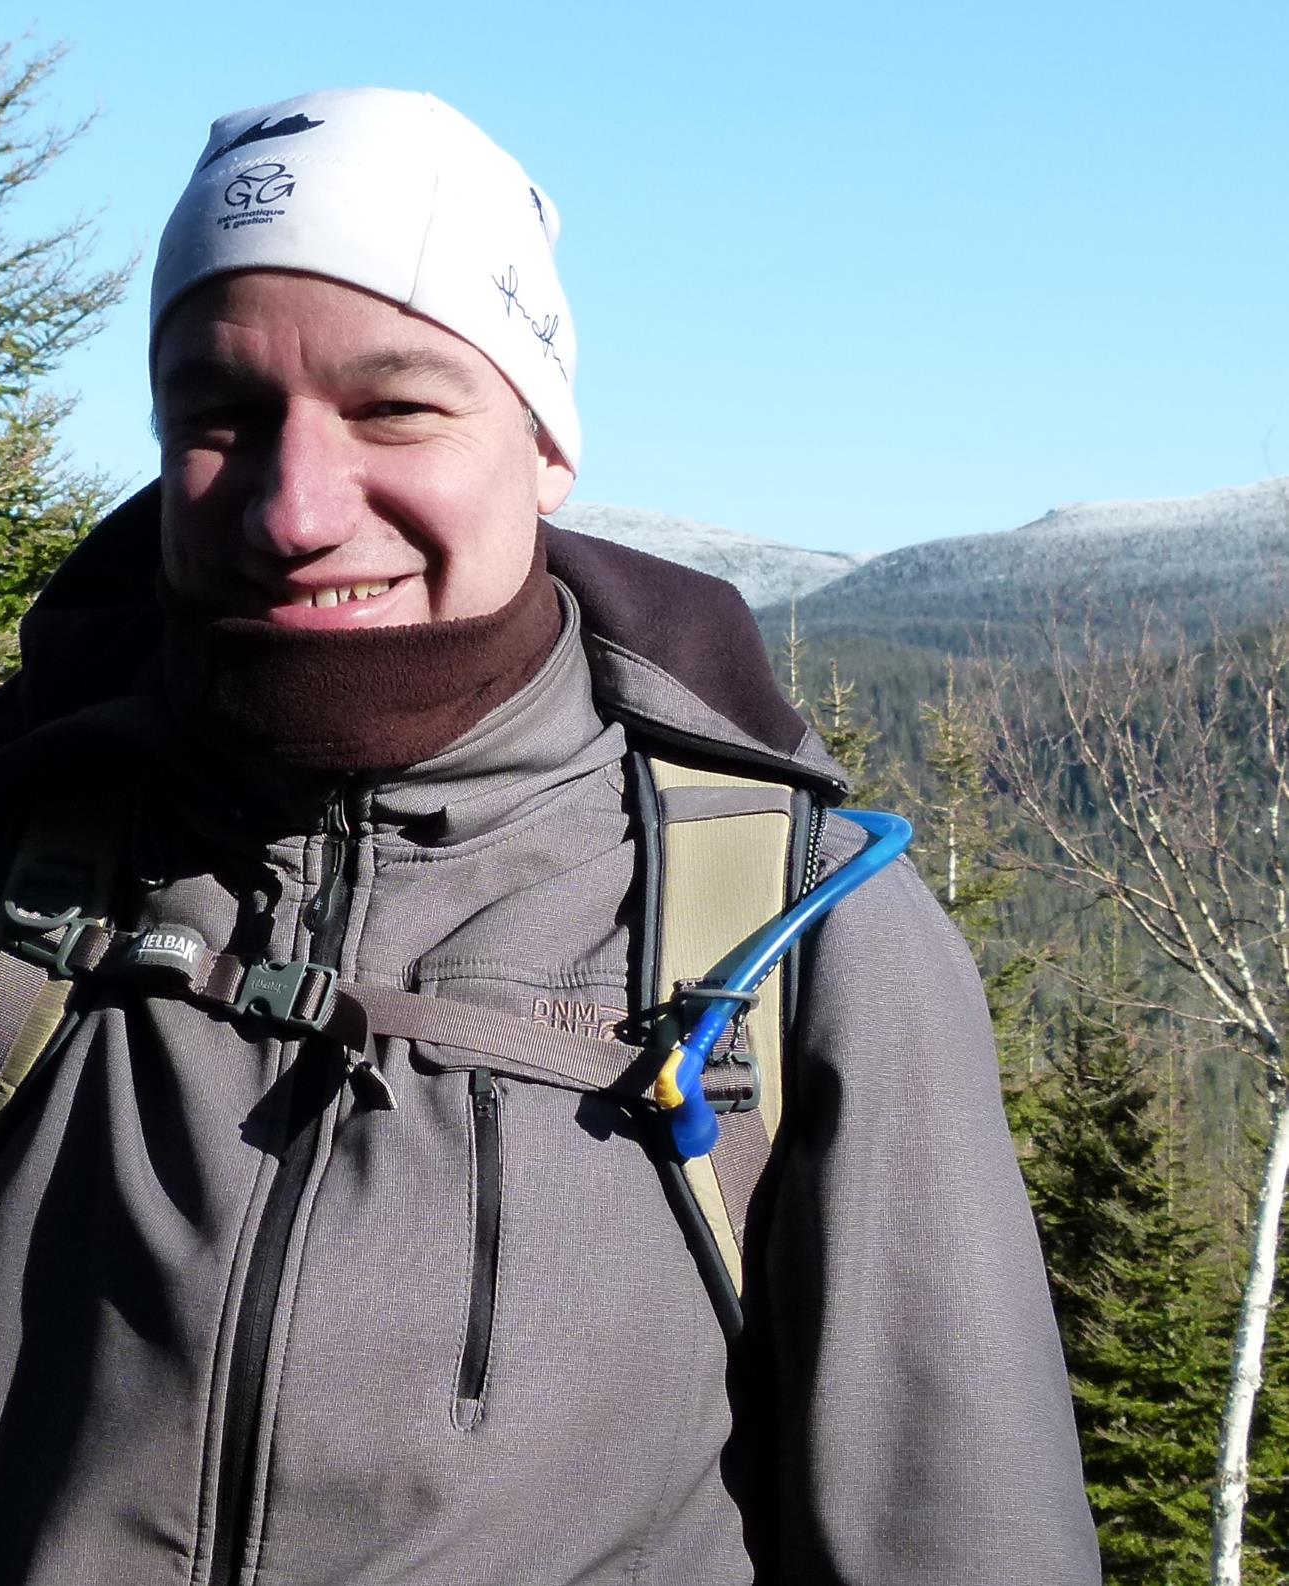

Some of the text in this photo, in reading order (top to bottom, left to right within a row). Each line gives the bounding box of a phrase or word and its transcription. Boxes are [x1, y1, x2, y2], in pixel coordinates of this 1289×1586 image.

[216, 209, 285, 225] informatique
[223, 217, 273, 230] & gestion
